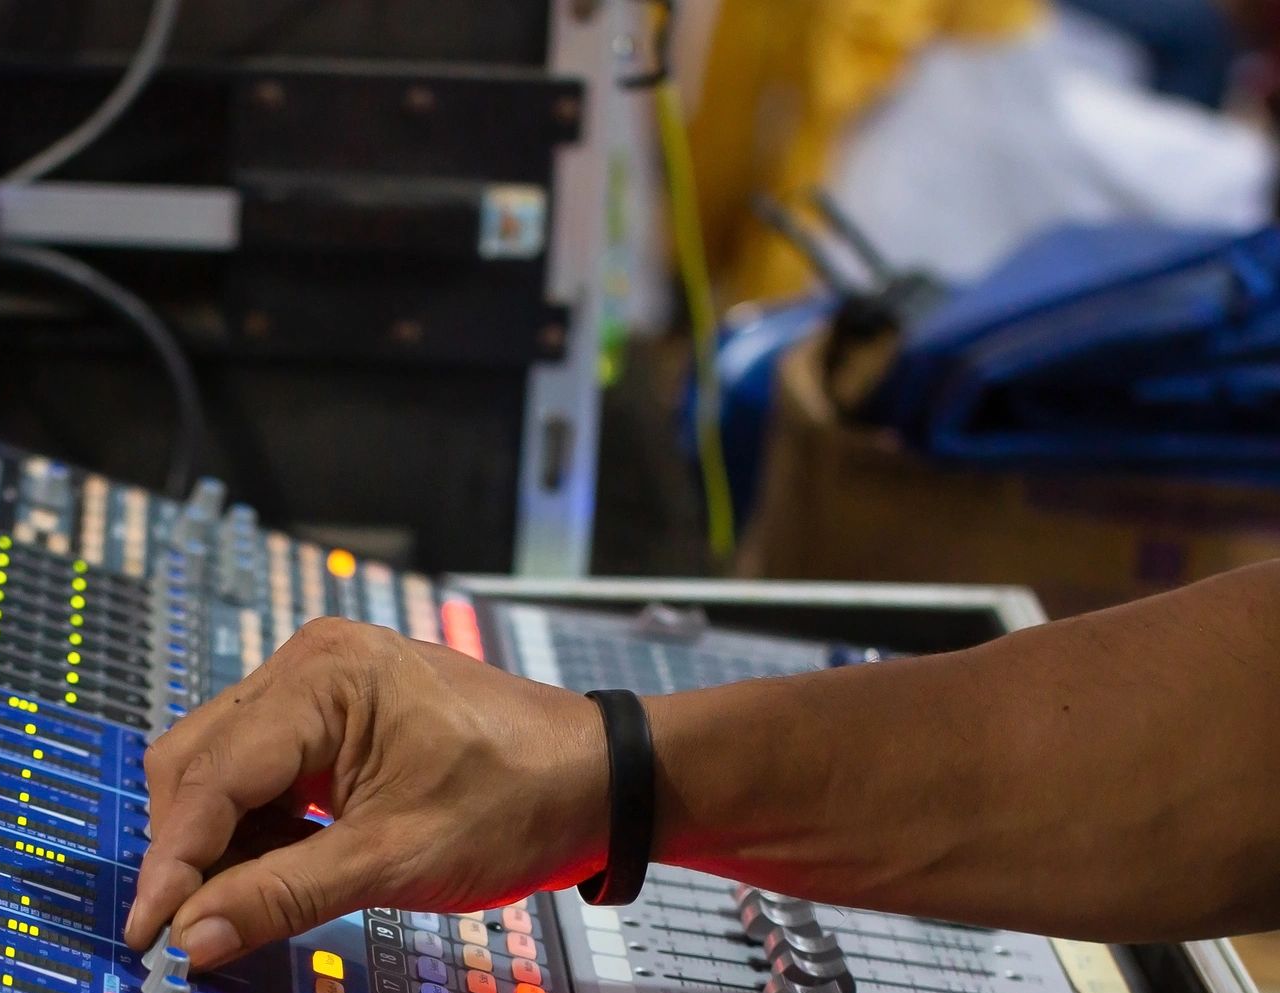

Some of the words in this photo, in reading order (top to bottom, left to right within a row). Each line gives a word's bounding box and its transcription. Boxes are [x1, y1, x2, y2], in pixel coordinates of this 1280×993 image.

[376, 926, 394, 939] 19
[380, 952, 397, 965] 18
[384, 979, 401, 992] 17
